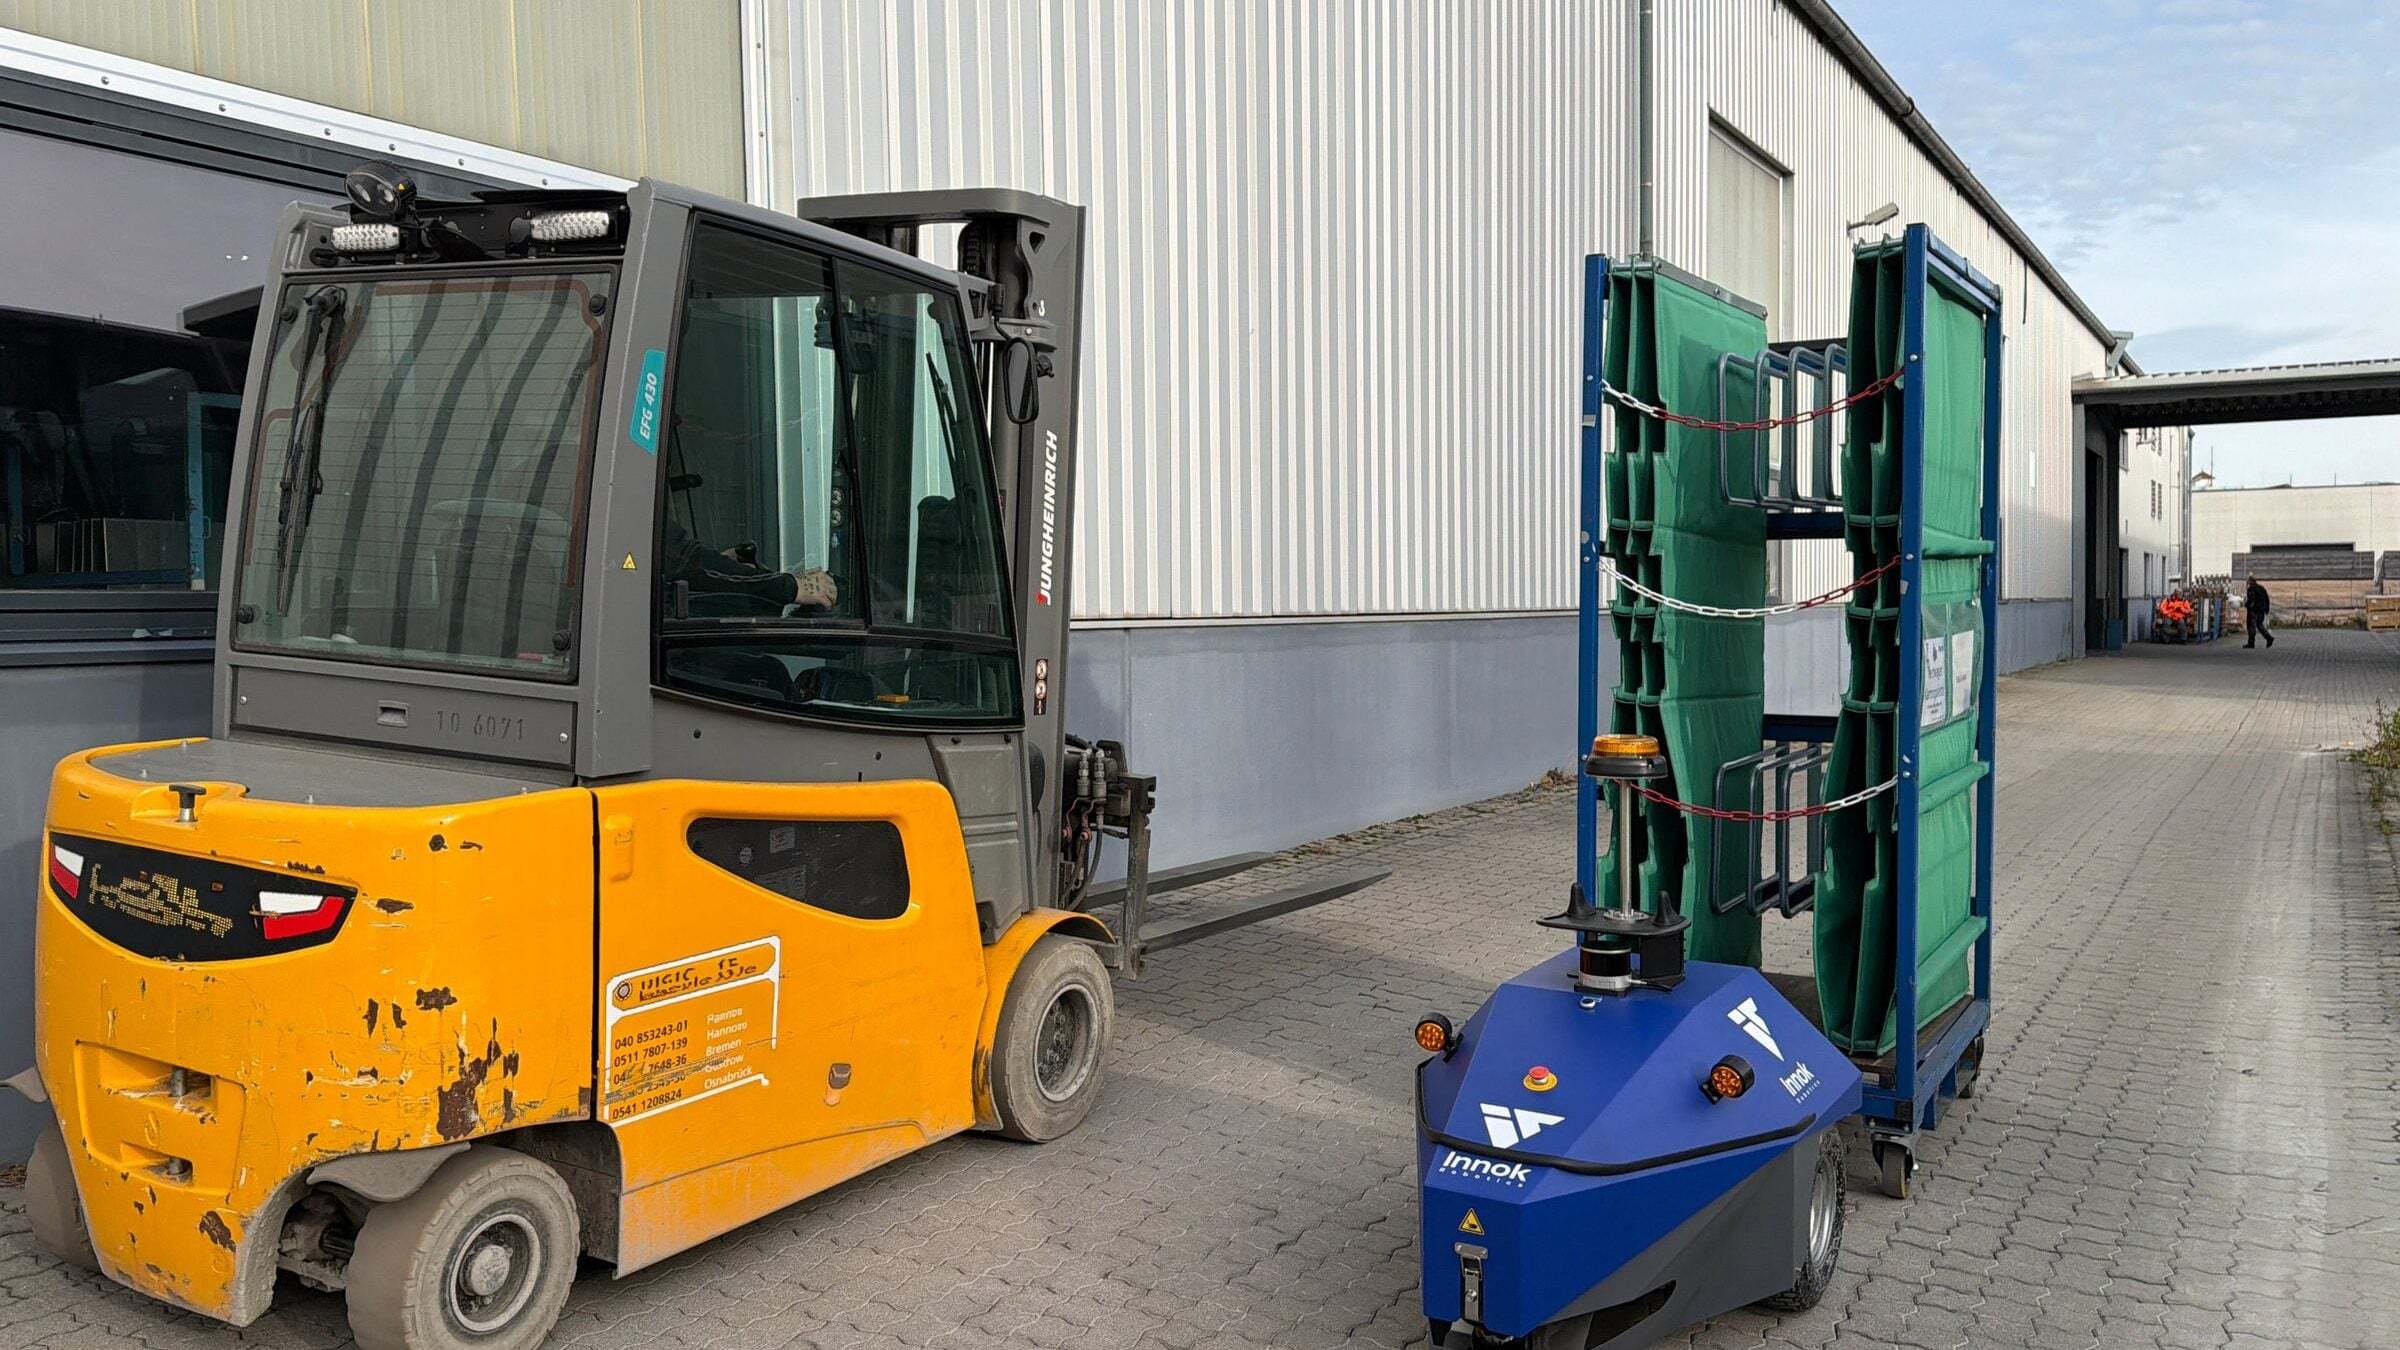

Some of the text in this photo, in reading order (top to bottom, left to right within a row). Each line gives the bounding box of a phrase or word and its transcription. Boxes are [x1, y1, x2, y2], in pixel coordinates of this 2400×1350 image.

[640, 372, 657, 440] EFG 430
[1036, 430, 1058, 606] JUNGHEINRICH
[437, 710, 523, 740] 10 6071
[614, 1020, 688, 1050] 040 853243-01
[614, 1037, 688, 1067] 0511 7807-139
[1779, 1061, 1815, 1097] Innok
[612, 1103, 636, 1120] 0541
[1443, 1151, 1533, 1182] Innok
